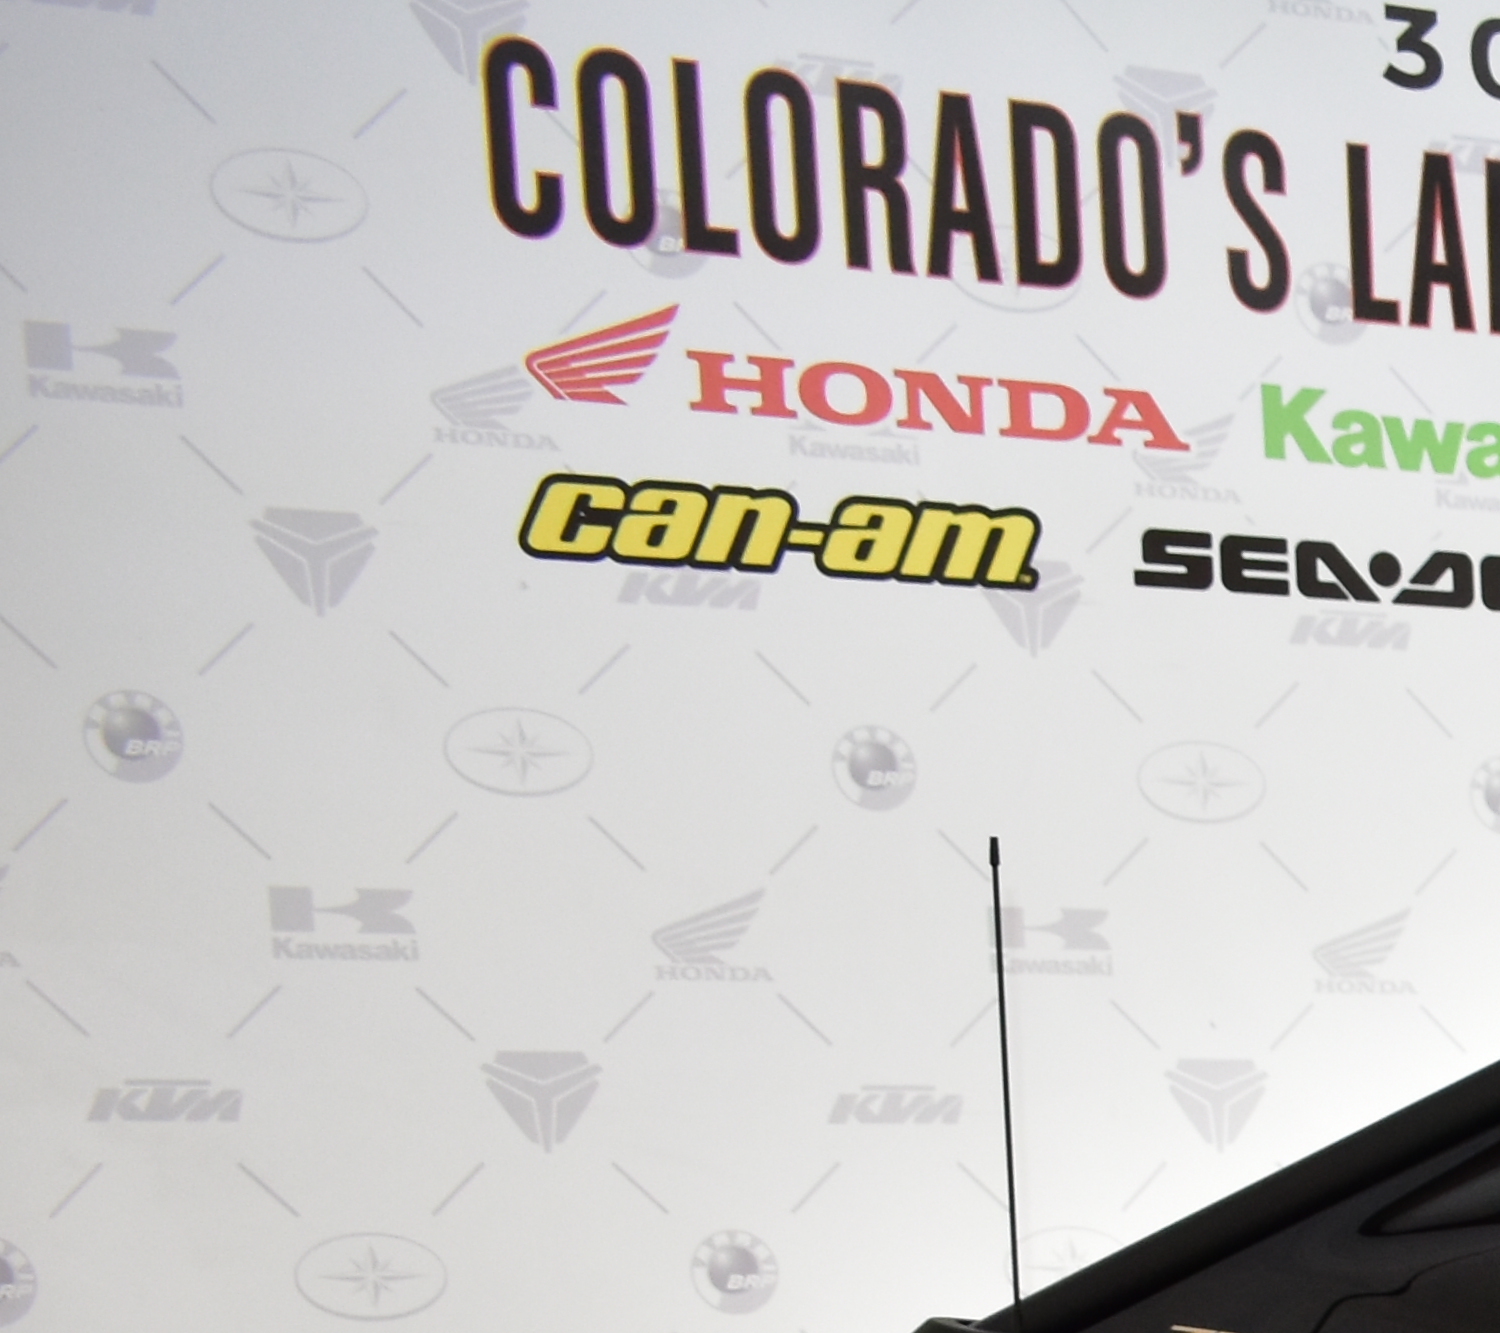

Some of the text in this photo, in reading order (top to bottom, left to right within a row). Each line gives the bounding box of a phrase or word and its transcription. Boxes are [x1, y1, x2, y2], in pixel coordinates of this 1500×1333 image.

[481, 35, 1292, 315] COLORADO'S
[27, 374, 184, 407] Kawasaki
[686, 349, 1191, 452] HONDA
[432, 427, 561, 451] HONDA
[270, 936, 420, 962] Kawasaki
[655, 963, 774, 983] HONDA
